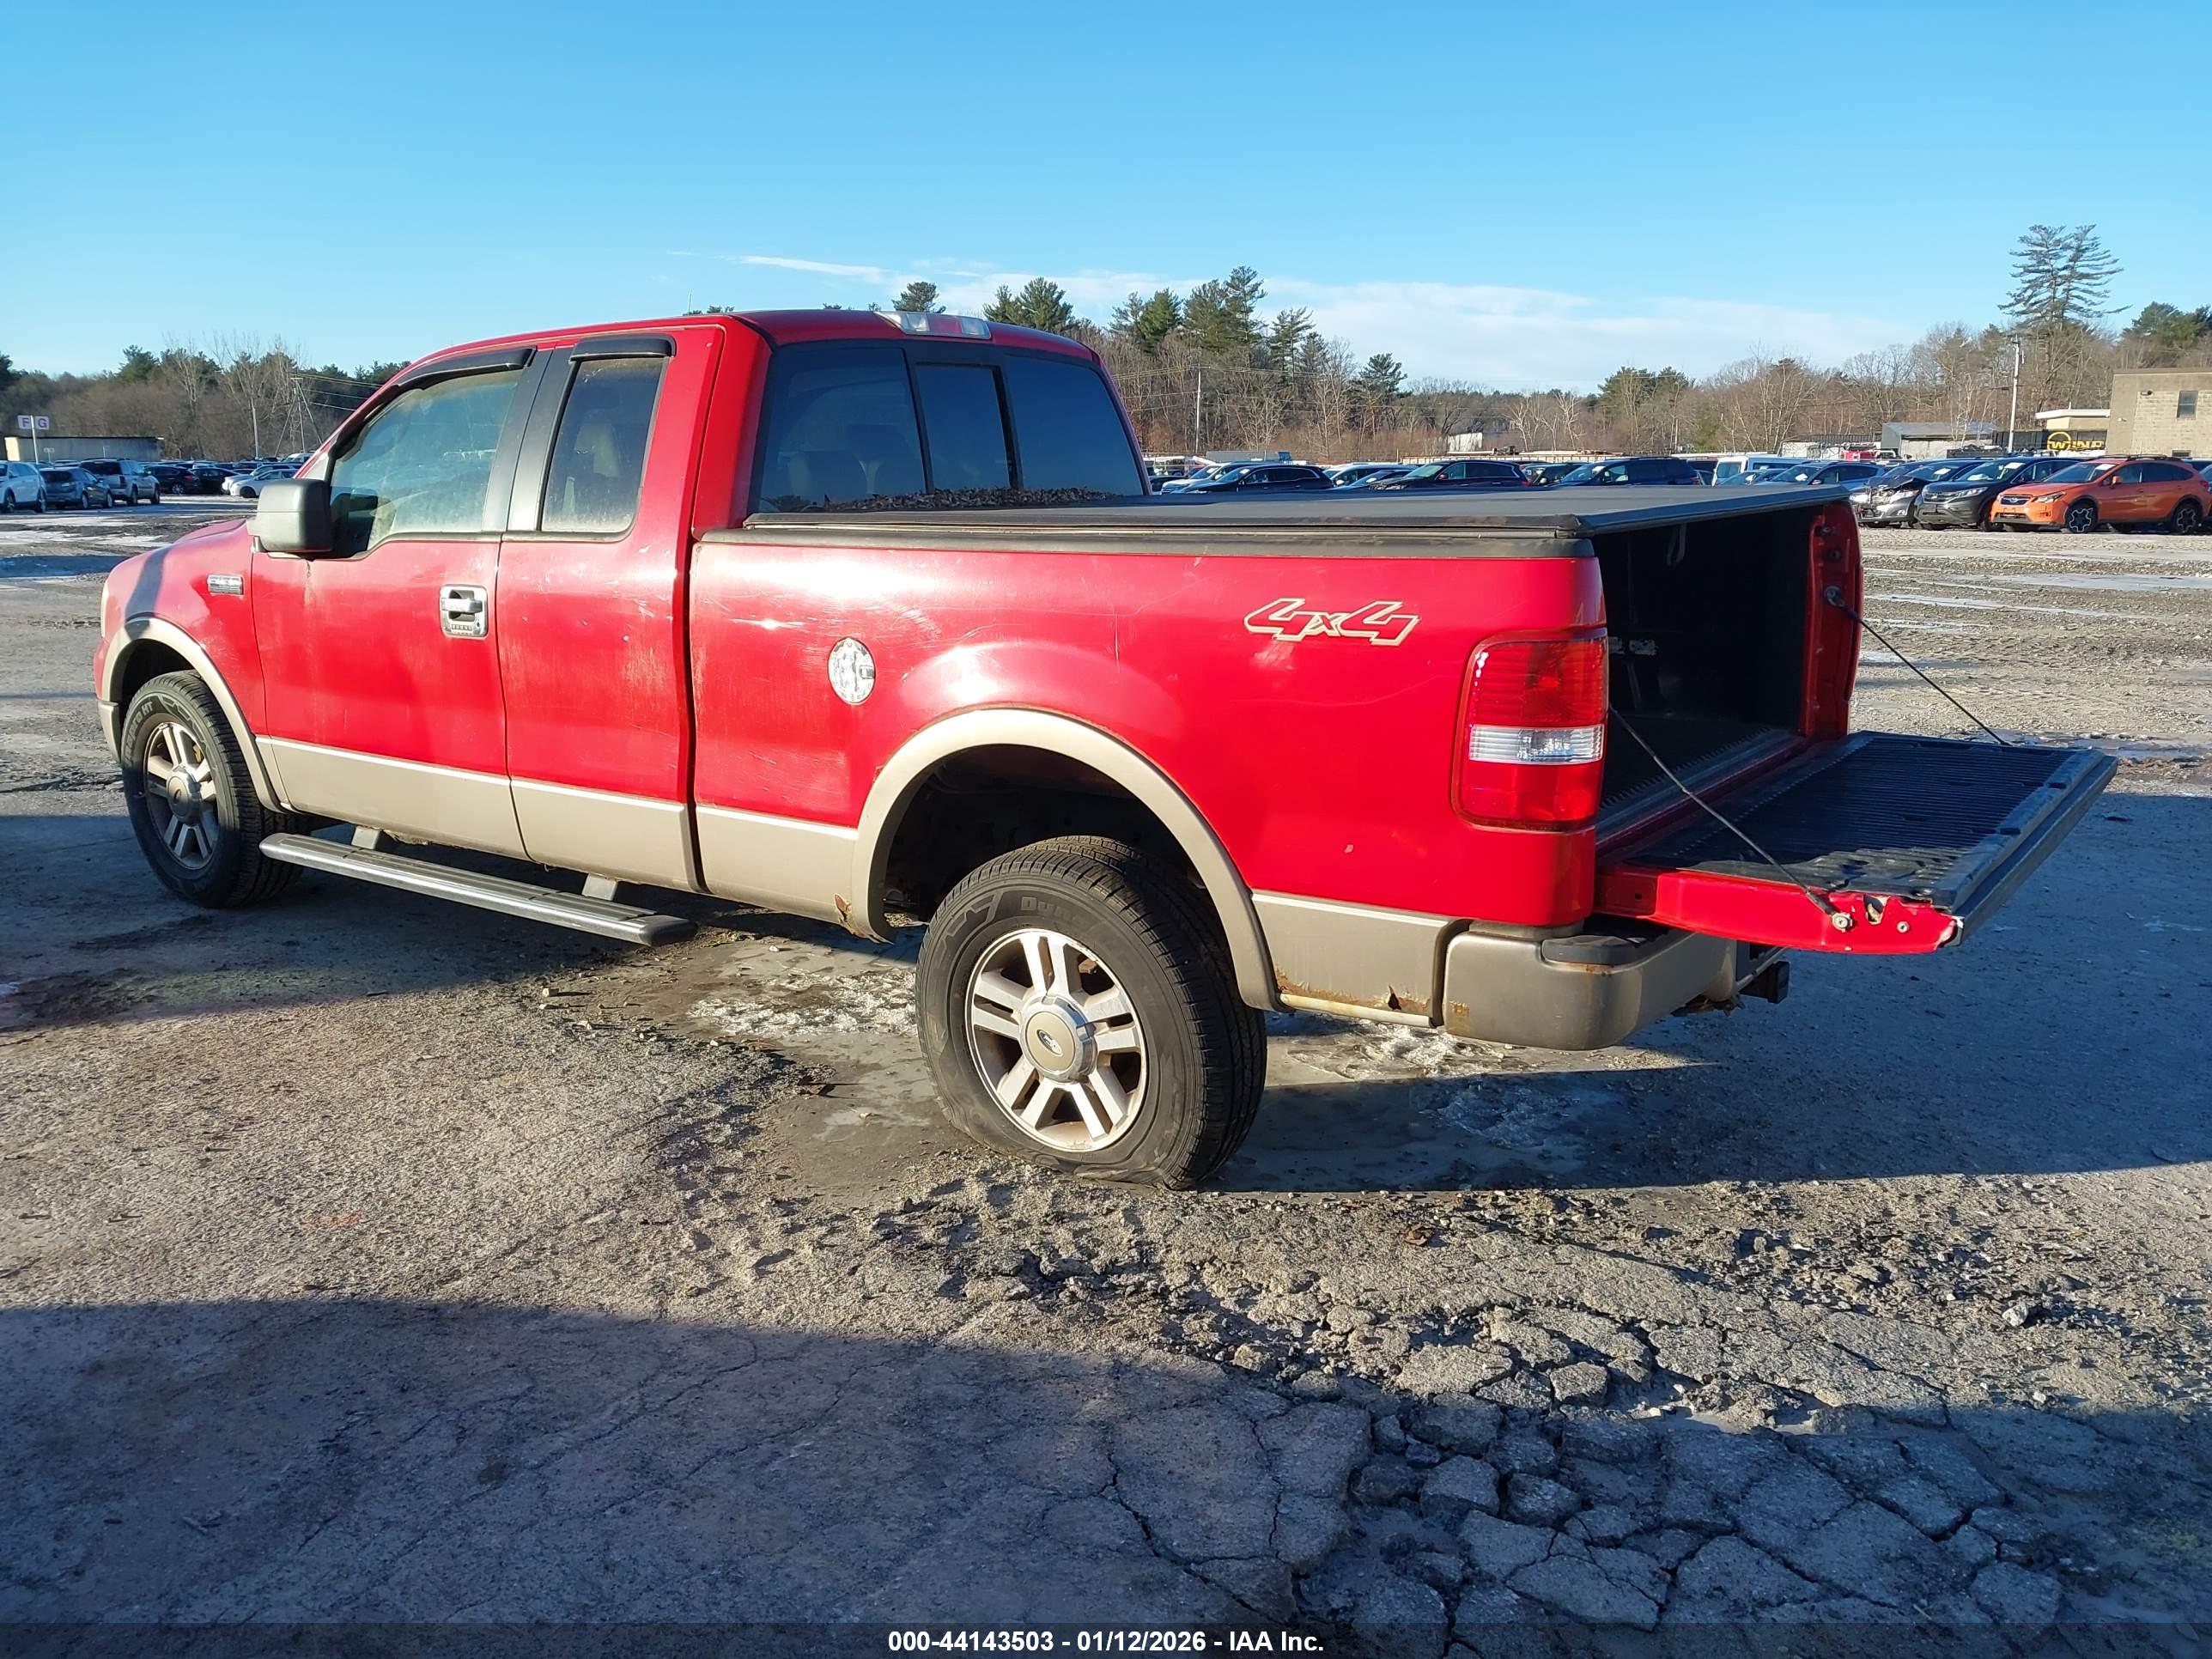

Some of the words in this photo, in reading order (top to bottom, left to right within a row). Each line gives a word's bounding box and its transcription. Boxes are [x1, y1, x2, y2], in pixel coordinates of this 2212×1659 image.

[22, 418, 29, 428] F
[38, 418, 48, 428] G
[141, 701, 154, 716] HT
